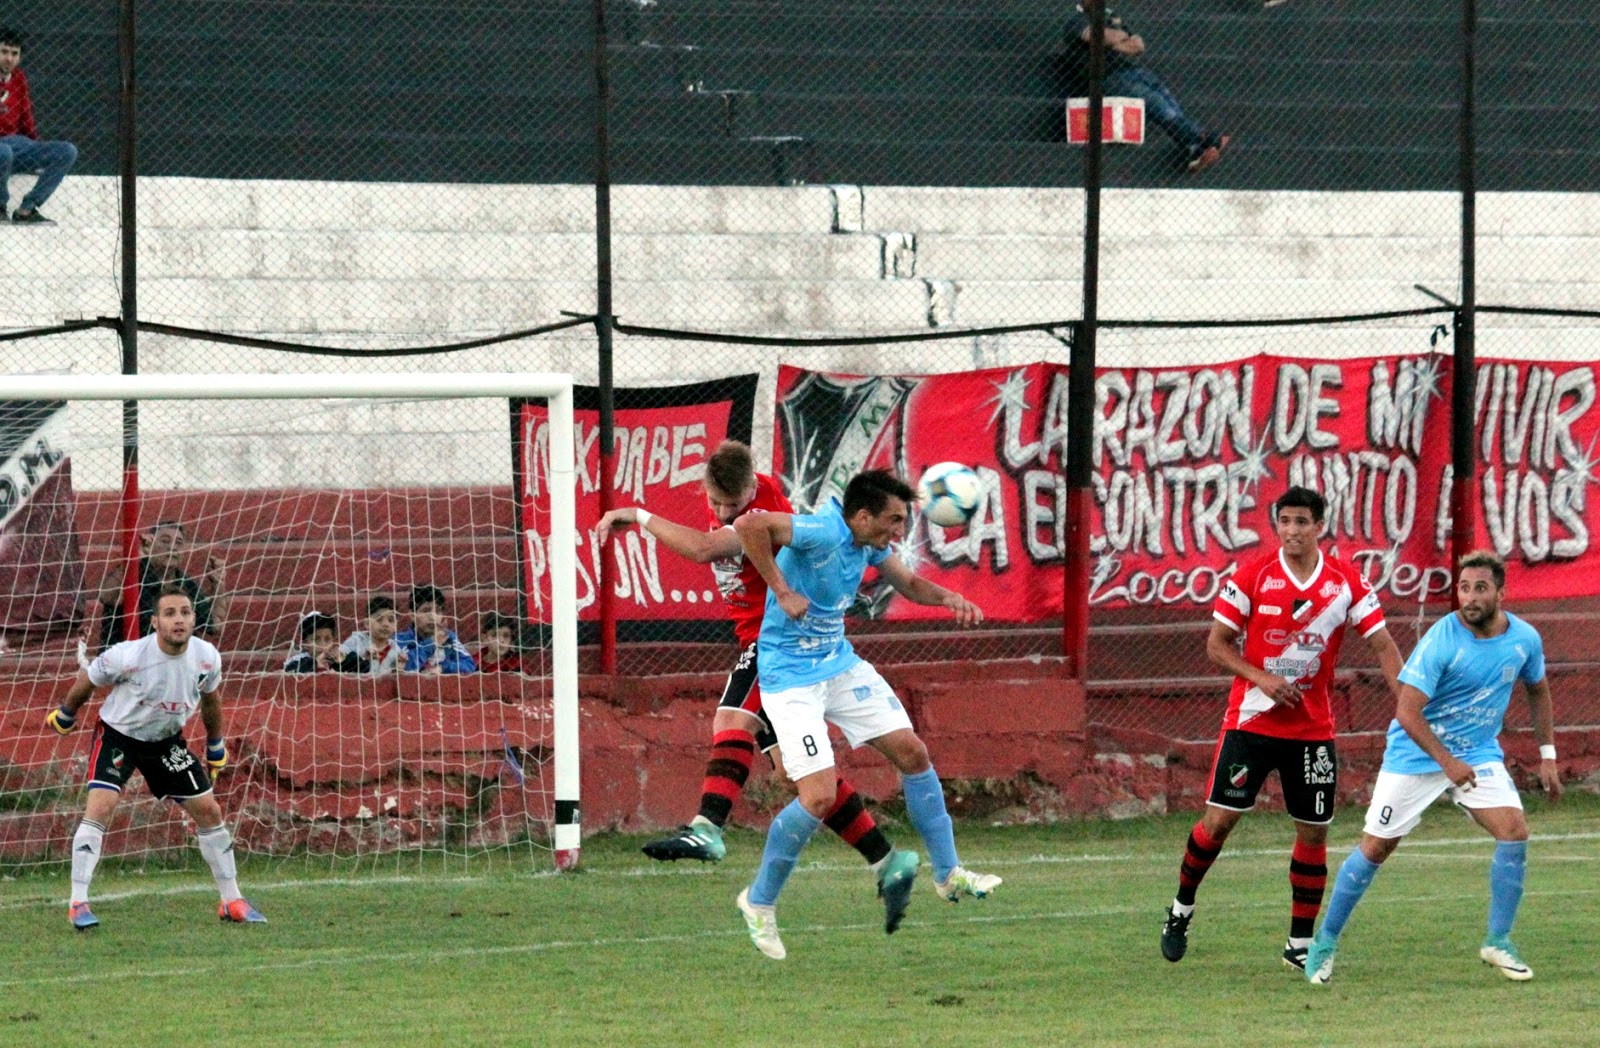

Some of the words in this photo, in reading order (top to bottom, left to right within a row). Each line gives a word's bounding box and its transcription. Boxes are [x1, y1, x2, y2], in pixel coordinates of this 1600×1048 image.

[1093, 364, 1255, 468] RAZON
[1274, 362, 1343, 453] DE
[1482, 466, 1589, 563] VOS
[803, 735, 818, 757] 8
[187, 770, 199, 791] 1
[1315, 790, 1325, 815] 6
[1379, 805, 1393, 825] 9
